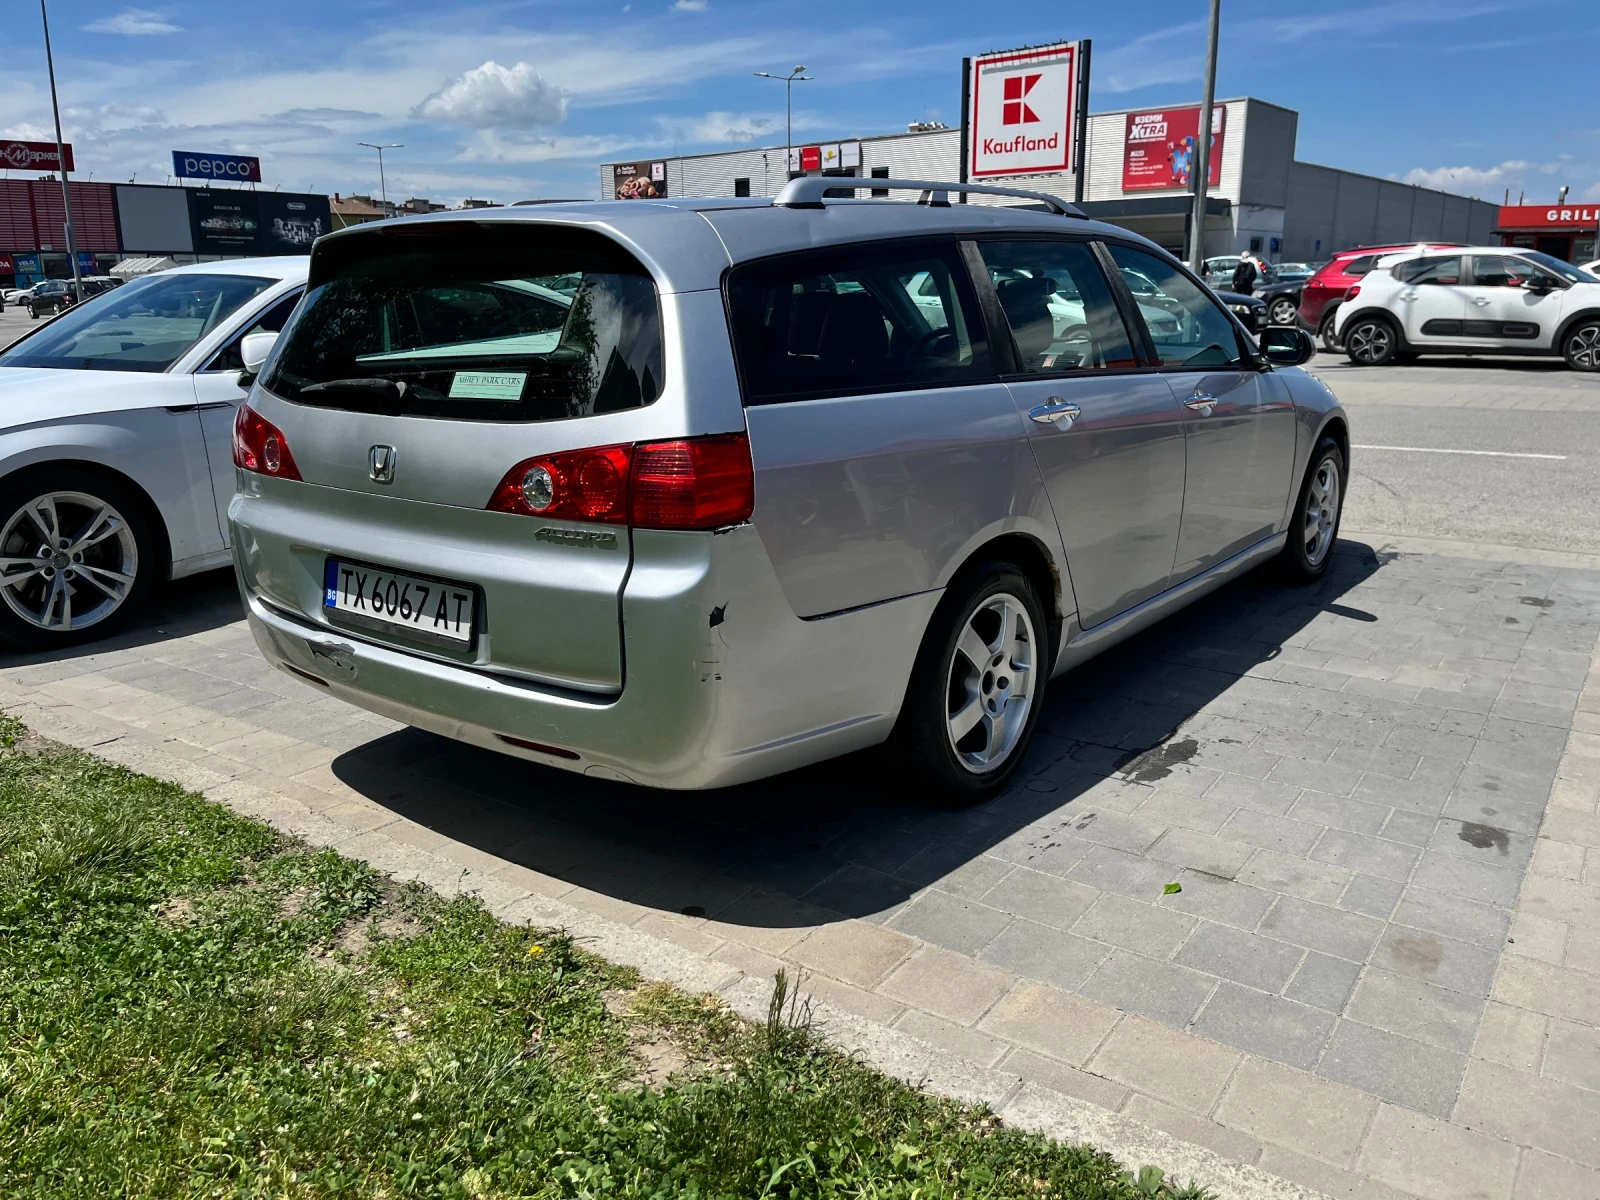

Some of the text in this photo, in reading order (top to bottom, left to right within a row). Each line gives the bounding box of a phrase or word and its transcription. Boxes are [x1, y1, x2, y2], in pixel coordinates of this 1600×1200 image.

[1135, 114, 1163, 124] ВЗЕМИ
[1129, 122, 1167, 140] XTRA
[983, 132, 1058, 155] Kaufland
[184, 158, 250, 177] pepco
[458, 376, 521, 386] ABBEY PARK CARS
[534, 527, 616, 542] ACCORD
[327, 588, 336, 601] BG
[341, 568, 468, 633] TX 6067 AT
